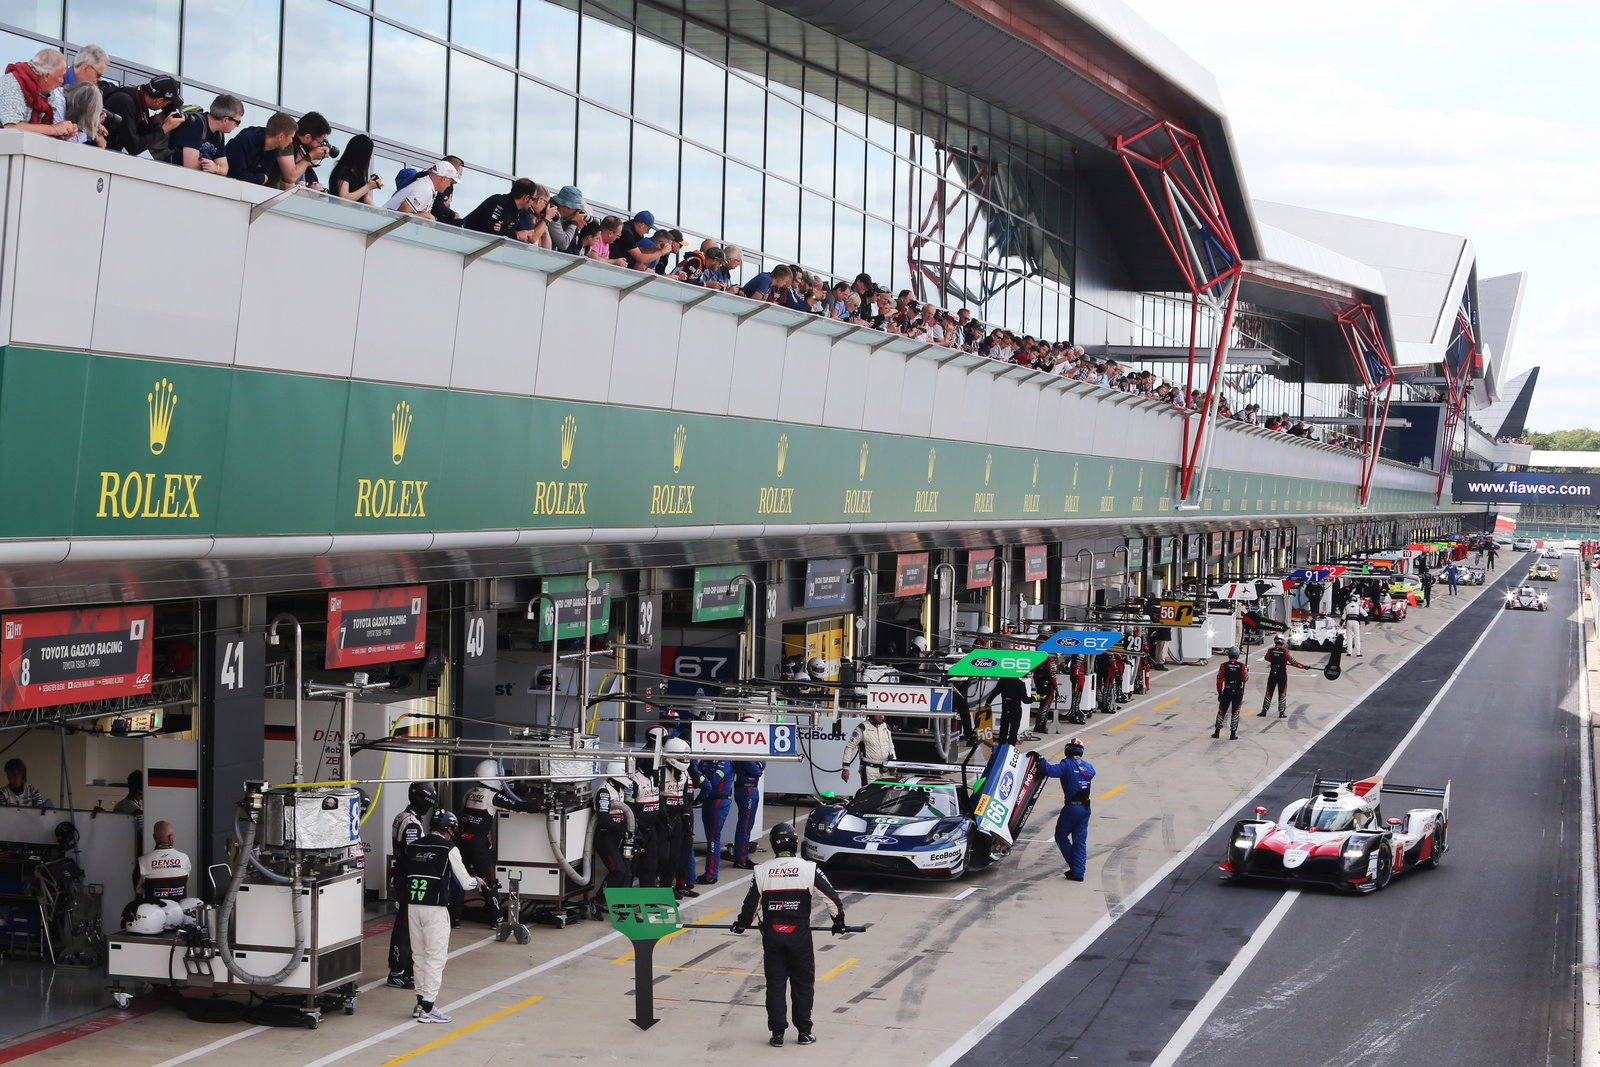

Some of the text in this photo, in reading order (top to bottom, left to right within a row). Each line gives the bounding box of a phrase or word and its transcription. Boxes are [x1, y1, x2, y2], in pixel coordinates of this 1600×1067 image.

[96, 471, 202, 519] ROLEX
[354, 478, 428, 518] ROLEX
[533, 481, 588, 515] ROLEX
[1468, 480, 1591, 496] www.fiawec.com
[650, 484, 695, 515] ROLEX
[758, 487, 794, 514] ROLEX
[843, 489, 873, 514] ROLEX
[914, 491, 939, 513] ROLEX
[973, 493, 995, 513] ROLEX
[1305, 570, 1319, 582] 91
[1227, 584, 1237, 598] 1
[767, 589, 777, 619] 38
[1160, 606, 1175, 619] 56
[353, 615, 407, 629] TOYOTA GAZOO RACING
[544, 606, 555, 626] 66
[640, 601, 653, 635] 39
[340, 627, 346, 649] 7
[466, 617, 485, 658] 40
[1060, 637, 1109, 648] Ford 67
[1126, 635, 1142, 652] 29
[41, 641, 123, 660] TOYOTA GAZOO RACING
[21, 658, 31, 686] 8
[221, 641, 244, 690] 41
[675, 655, 728, 678] 67
[974, 657, 1031, 670] Ford 66
[869, 688, 949, 711] TOYOTA 7
[696, 725, 791, 752] TOYOTA 8
[977, 726, 993, 740] 56
[880, 784, 934, 793] FORD
[1000, 775, 1013, 798] Ford
[977, 797, 989, 813] DHL
[986, 800, 1006, 824] 66
[352, 801, 360, 836] 8
[863, 835, 890, 844] Ford
[151, 858, 181, 867] DENSO
[930, 848, 962, 862] EcoBoost
[768, 867, 799, 875] DENSO
[411, 878, 428, 890] 32
[410, 890, 426, 901] TV
